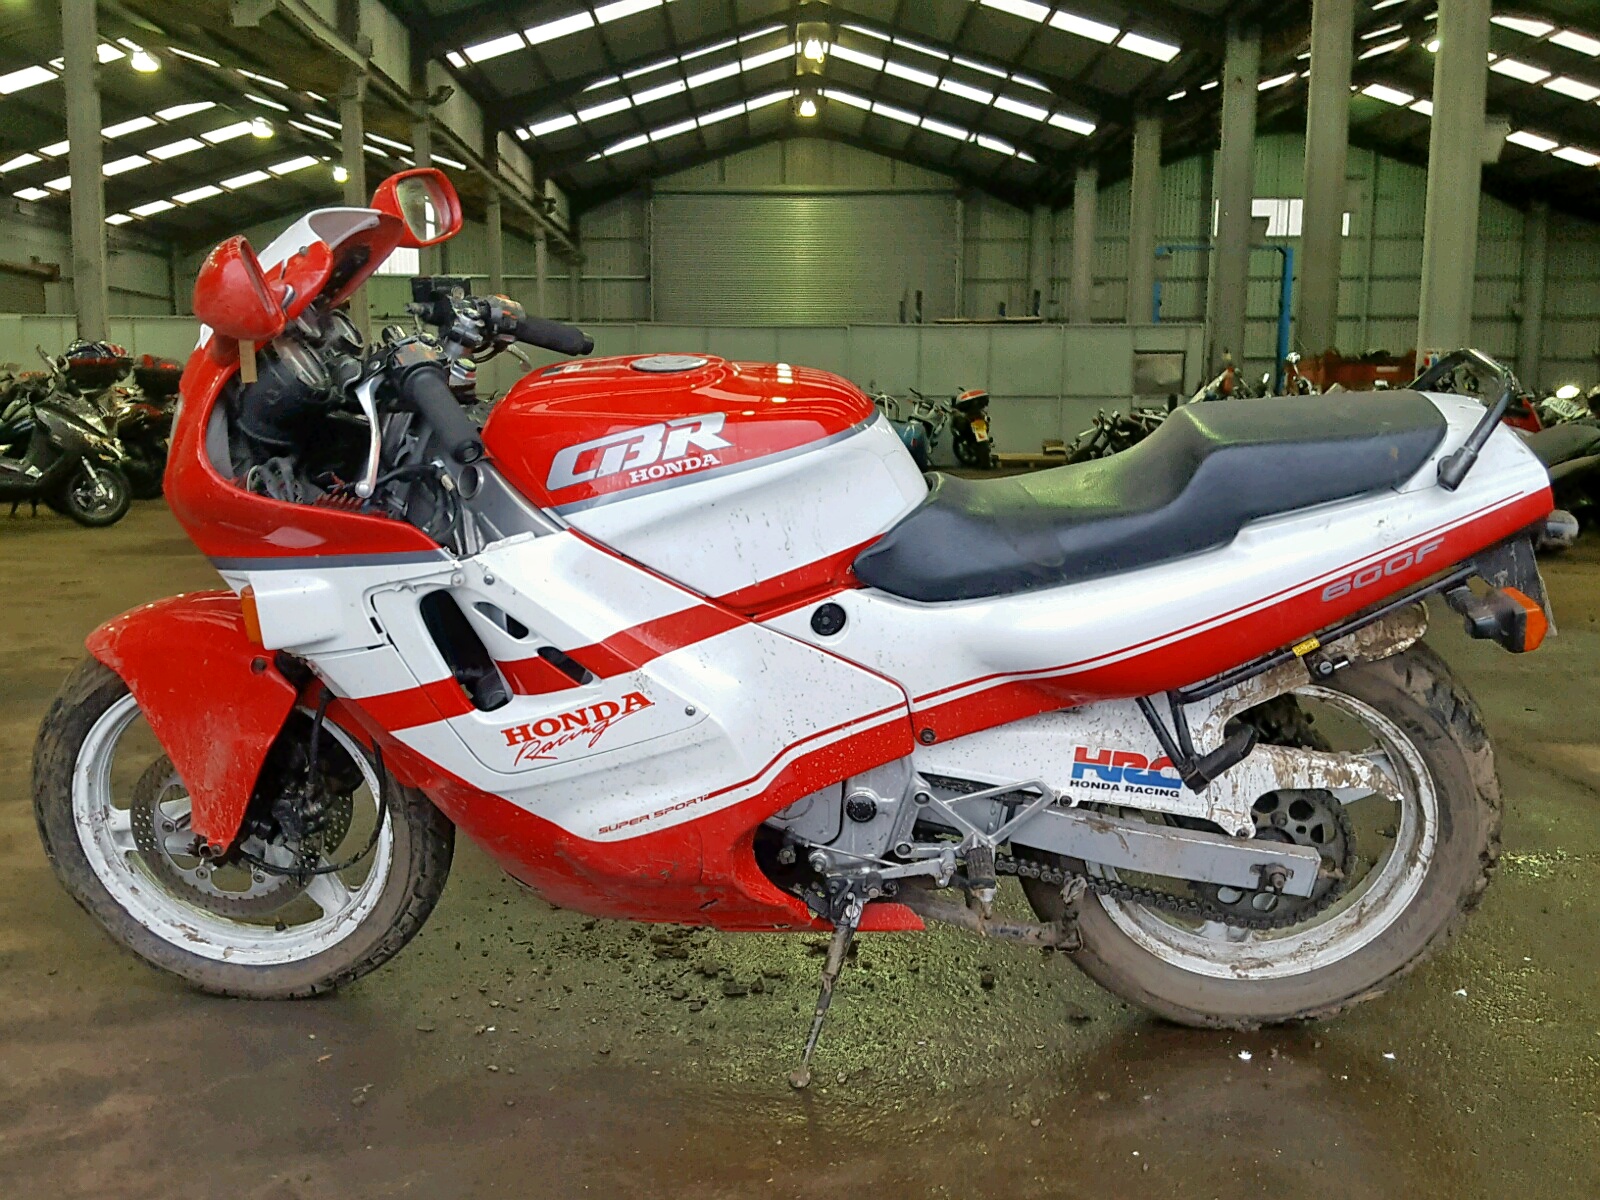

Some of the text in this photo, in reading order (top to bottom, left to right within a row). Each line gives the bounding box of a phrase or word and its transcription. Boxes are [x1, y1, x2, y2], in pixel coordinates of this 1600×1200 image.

[546, 411, 734, 491] CBR
[629, 453, 721, 483] HONDA
[1321, 537, 1445, 602] 600F
[501, 691, 656, 747] HONDA
[513, 718, 656, 767] Racing
[1069, 780, 1181, 798] HONDA RACING
[1071, 746, 1182, 789] HRC
[598, 795, 705, 835] SUPER SPORT
